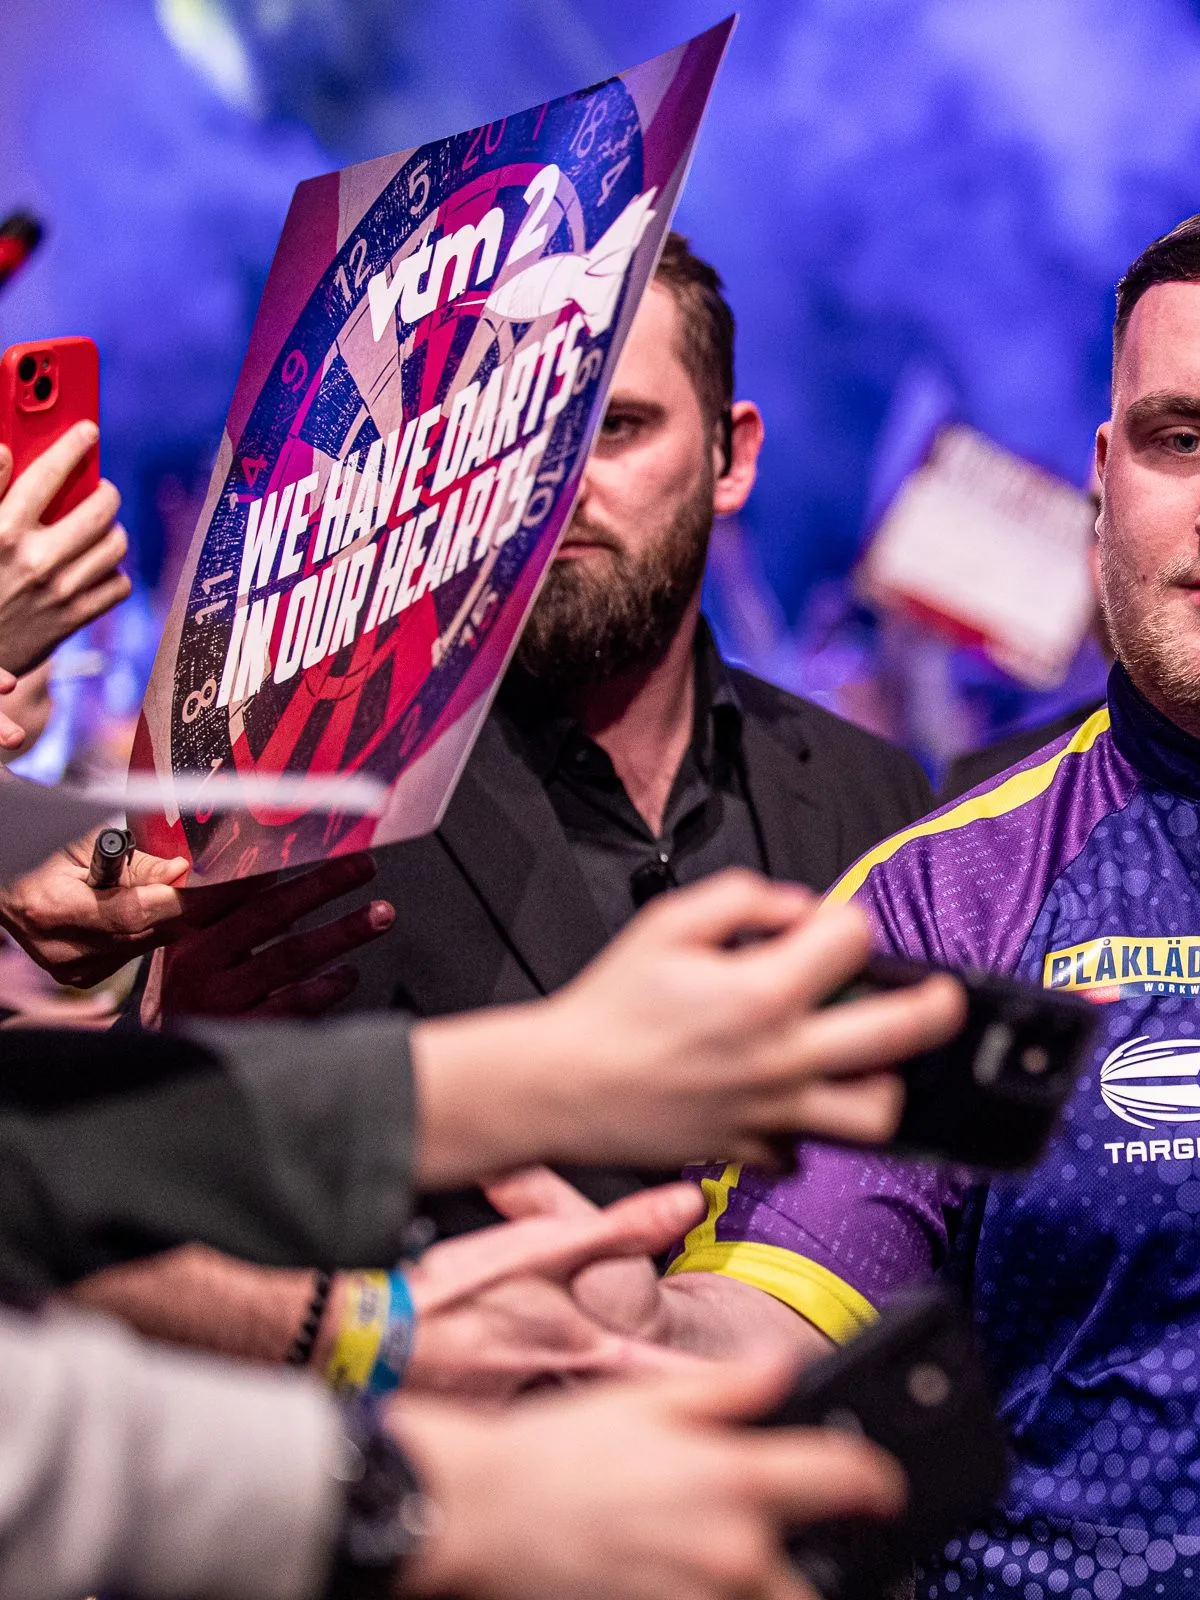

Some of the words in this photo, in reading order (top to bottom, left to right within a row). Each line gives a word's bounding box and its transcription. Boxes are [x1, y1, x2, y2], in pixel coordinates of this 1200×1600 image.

[333, 238, 371, 302] 12
[367, 207, 505, 342] vtm
[507, 163, 560, 267] 2
[408, 159, 430, 215] 5
[238, 471, 319, 599] WE
[311, 404, 442, 563] HAVE
[430, 312, 584, 496] DARTS
[215, 591, 280, 709] IN
[273, 543, 378, 684] OUR
[363, 430, 549, 634] HEARTS
